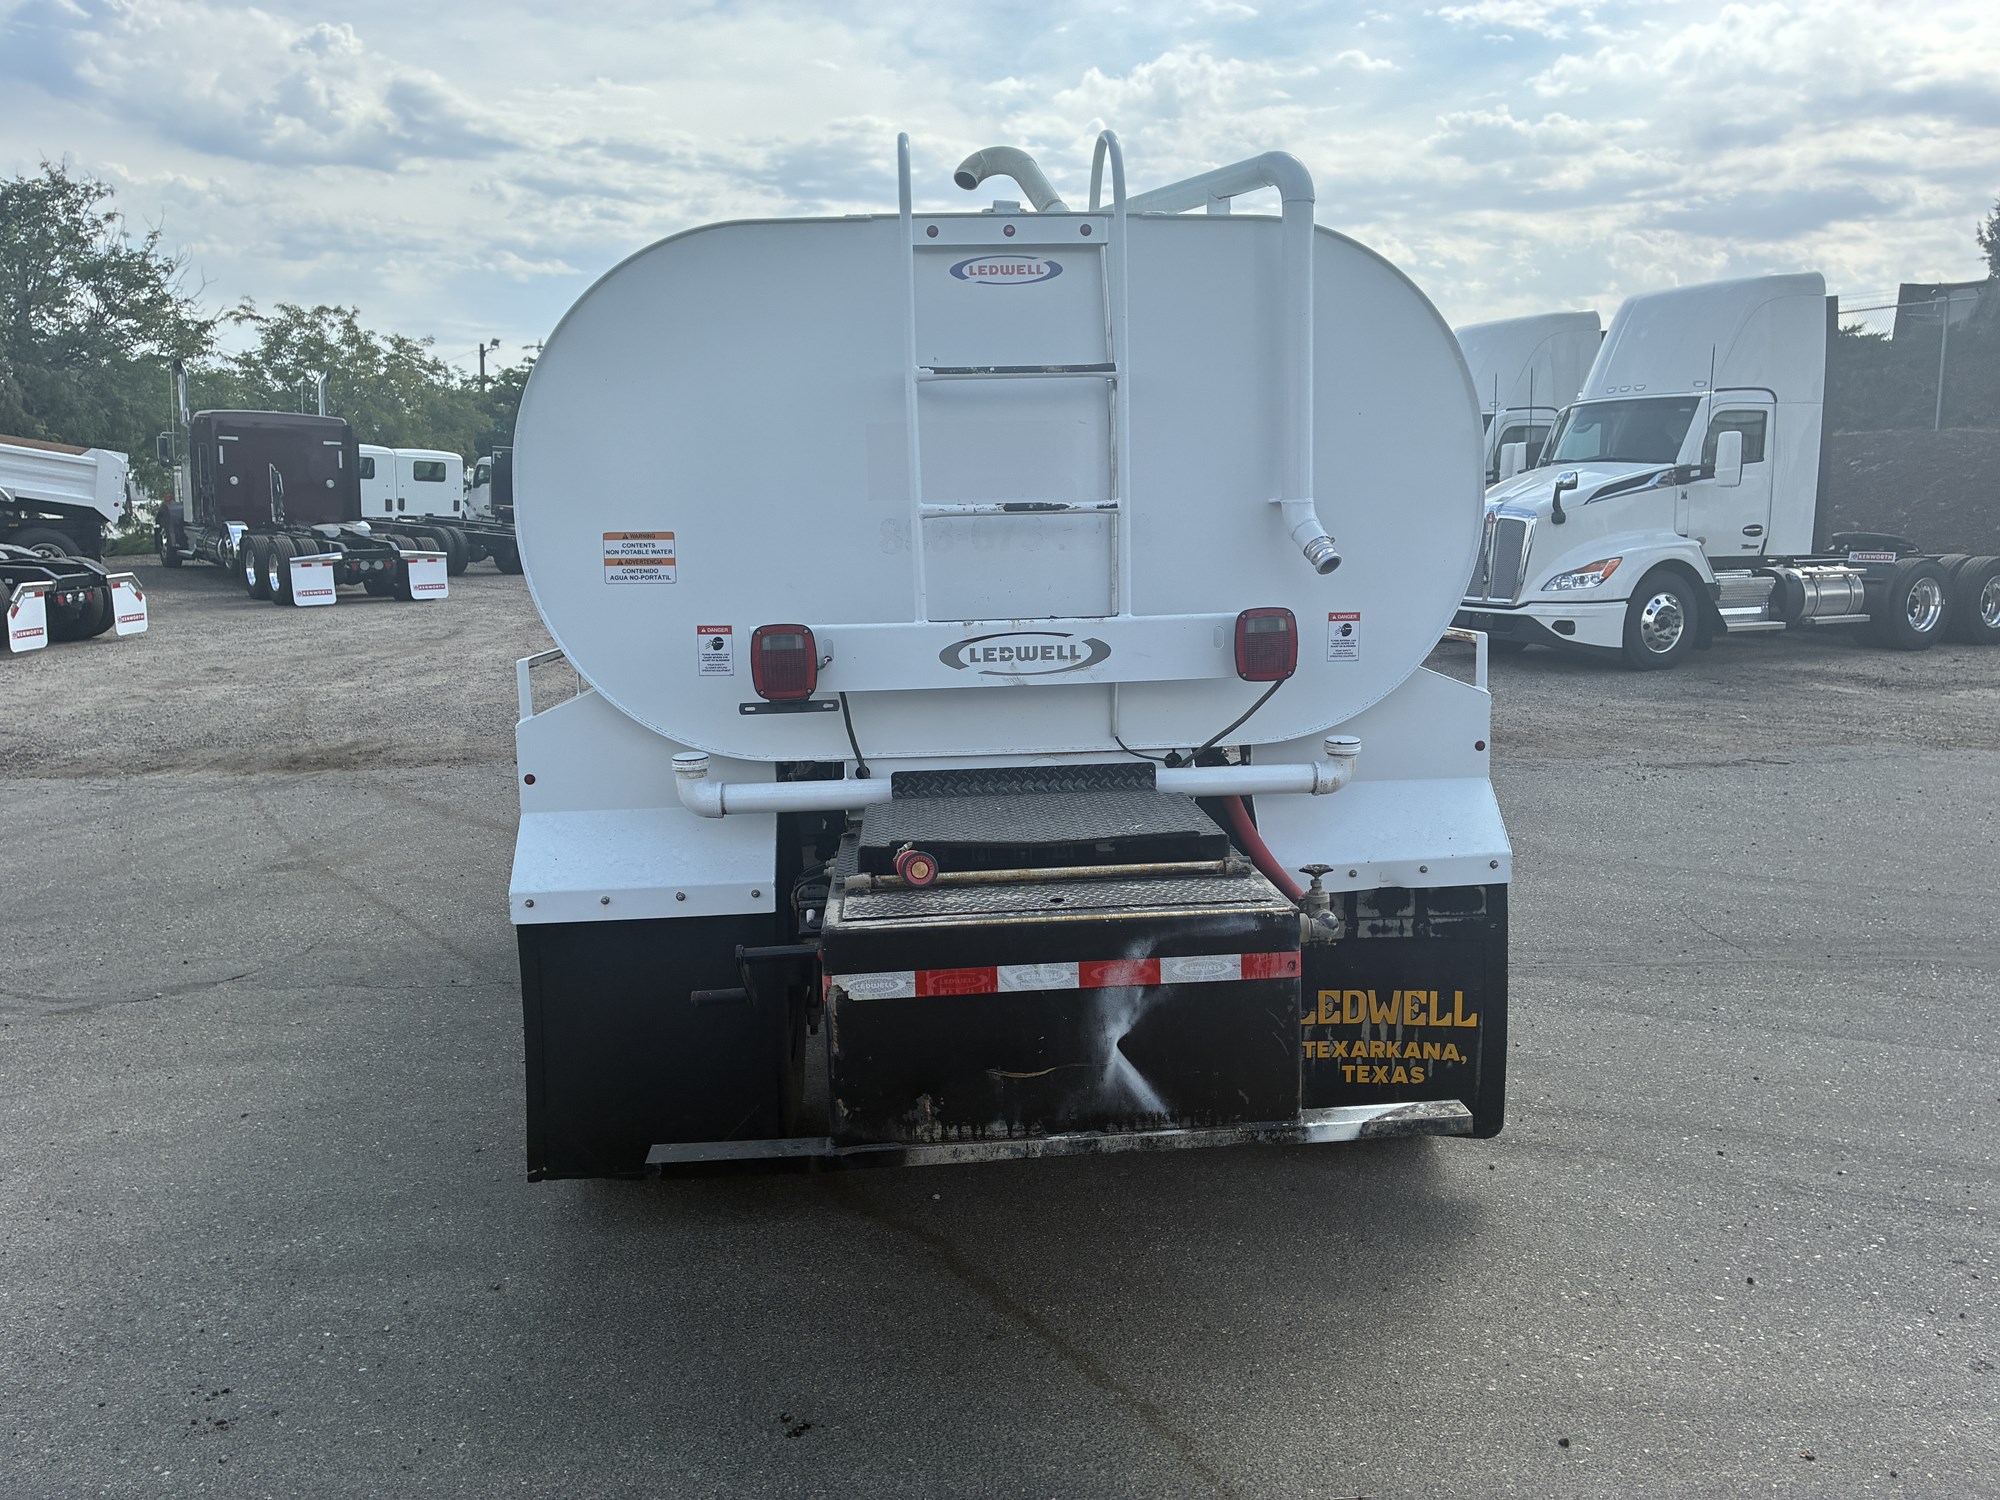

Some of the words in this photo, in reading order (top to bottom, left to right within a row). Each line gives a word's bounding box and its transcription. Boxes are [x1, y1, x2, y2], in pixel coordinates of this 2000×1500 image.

[968, 264, 1044, 276] LEDWELL
[1858, 553, 1893, 561] KENWORTH
[629, 573, 672, 581] NO-PORTÁTIL
[17, 628, 44, 638] KENWORTH
[969, 644, 1082, 663] LEDWELL
[855, 981, 894, 989] LEDWELL
[939, 977, 977, 985] LEDWELL
[1301, 1040, 1467, 1065] TEXARKANA,
[1341, 1065, 1425, 1084] TEXAS
